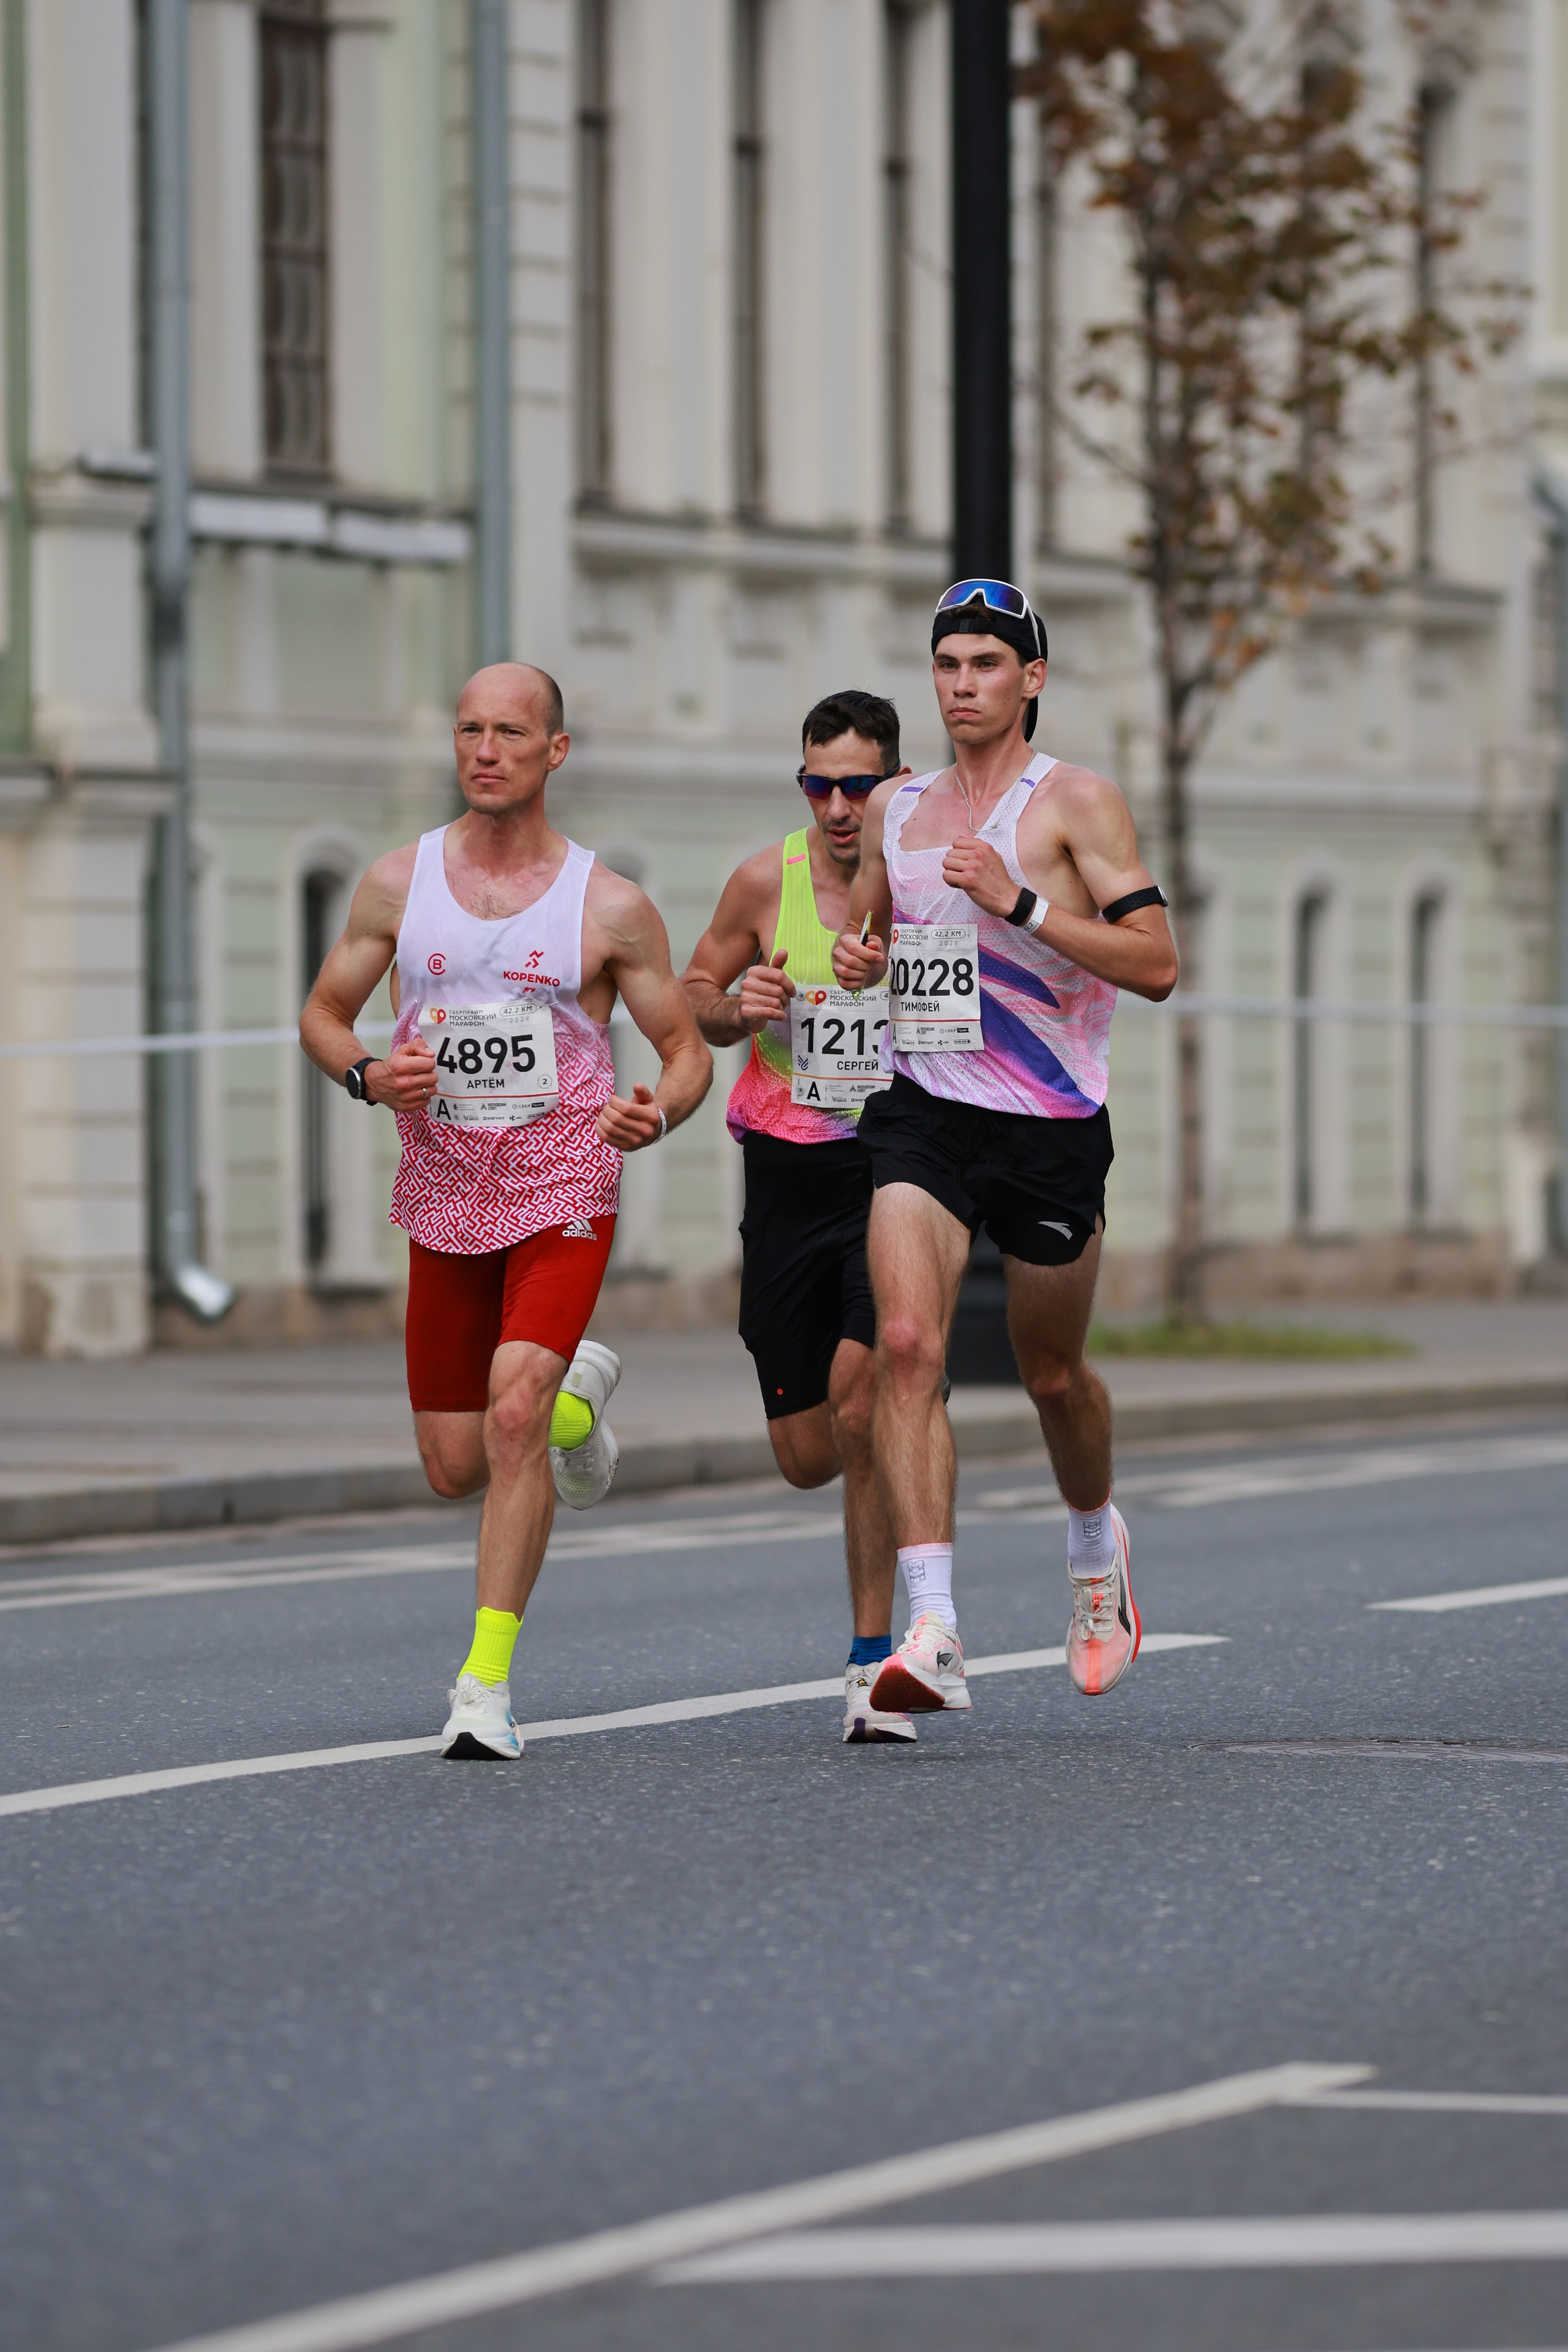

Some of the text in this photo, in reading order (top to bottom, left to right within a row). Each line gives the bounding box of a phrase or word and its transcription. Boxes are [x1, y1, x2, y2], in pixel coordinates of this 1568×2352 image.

[503, 971, 560, 987] KOPENKO
[891, 958, 974, 997] 20228
[900, 1001, 940, 1012] ТИМОФЕЙ
[437, 1034, 535, 1074] 4895
[837, 1060, 878, 1071] СЕРГЕЙ
[467, 1077, 505, 1089] АРТЁМ
[562, 1228, 597, 1241] adidas
